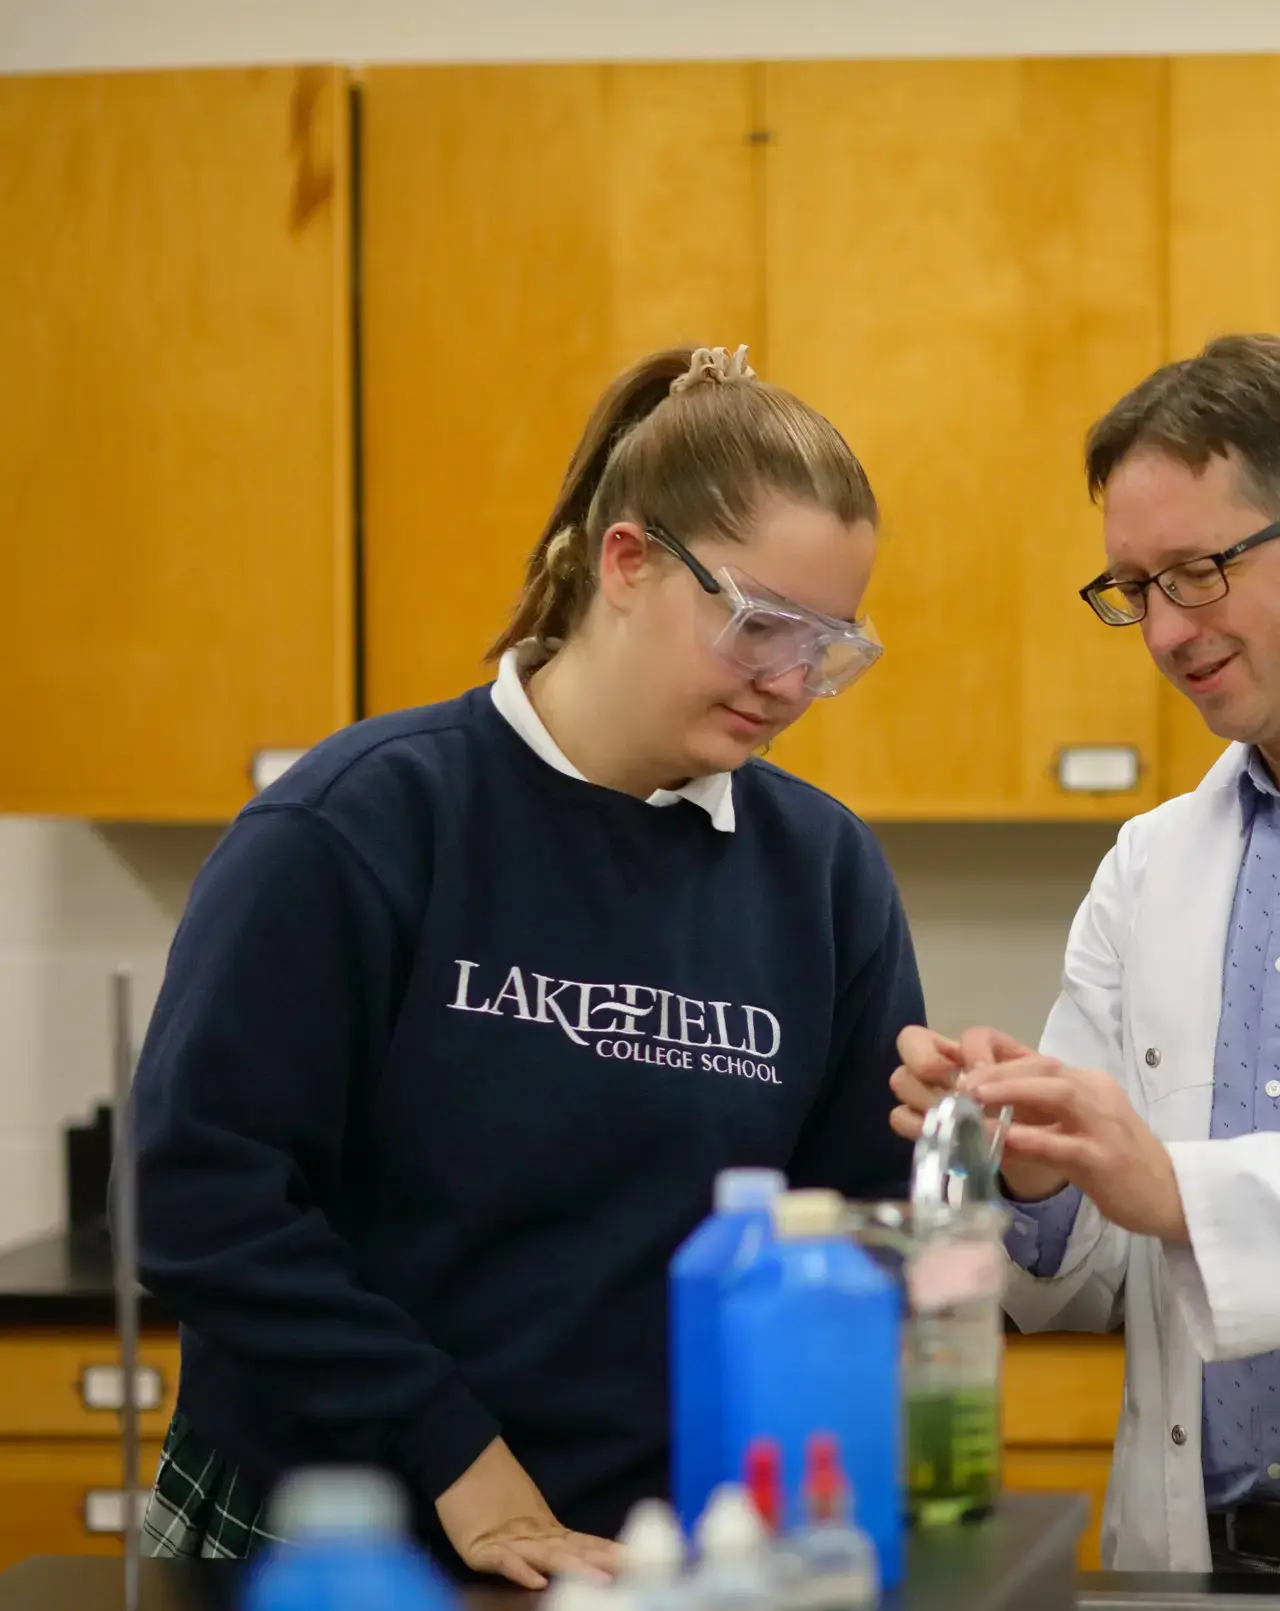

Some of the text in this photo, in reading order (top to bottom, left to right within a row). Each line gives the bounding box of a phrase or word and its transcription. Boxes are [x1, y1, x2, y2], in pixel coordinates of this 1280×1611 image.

[446, 959, 781, 1058] LAKEFIELD
[596, 1039, 783, 1084] COLLEGE SCHOOL
